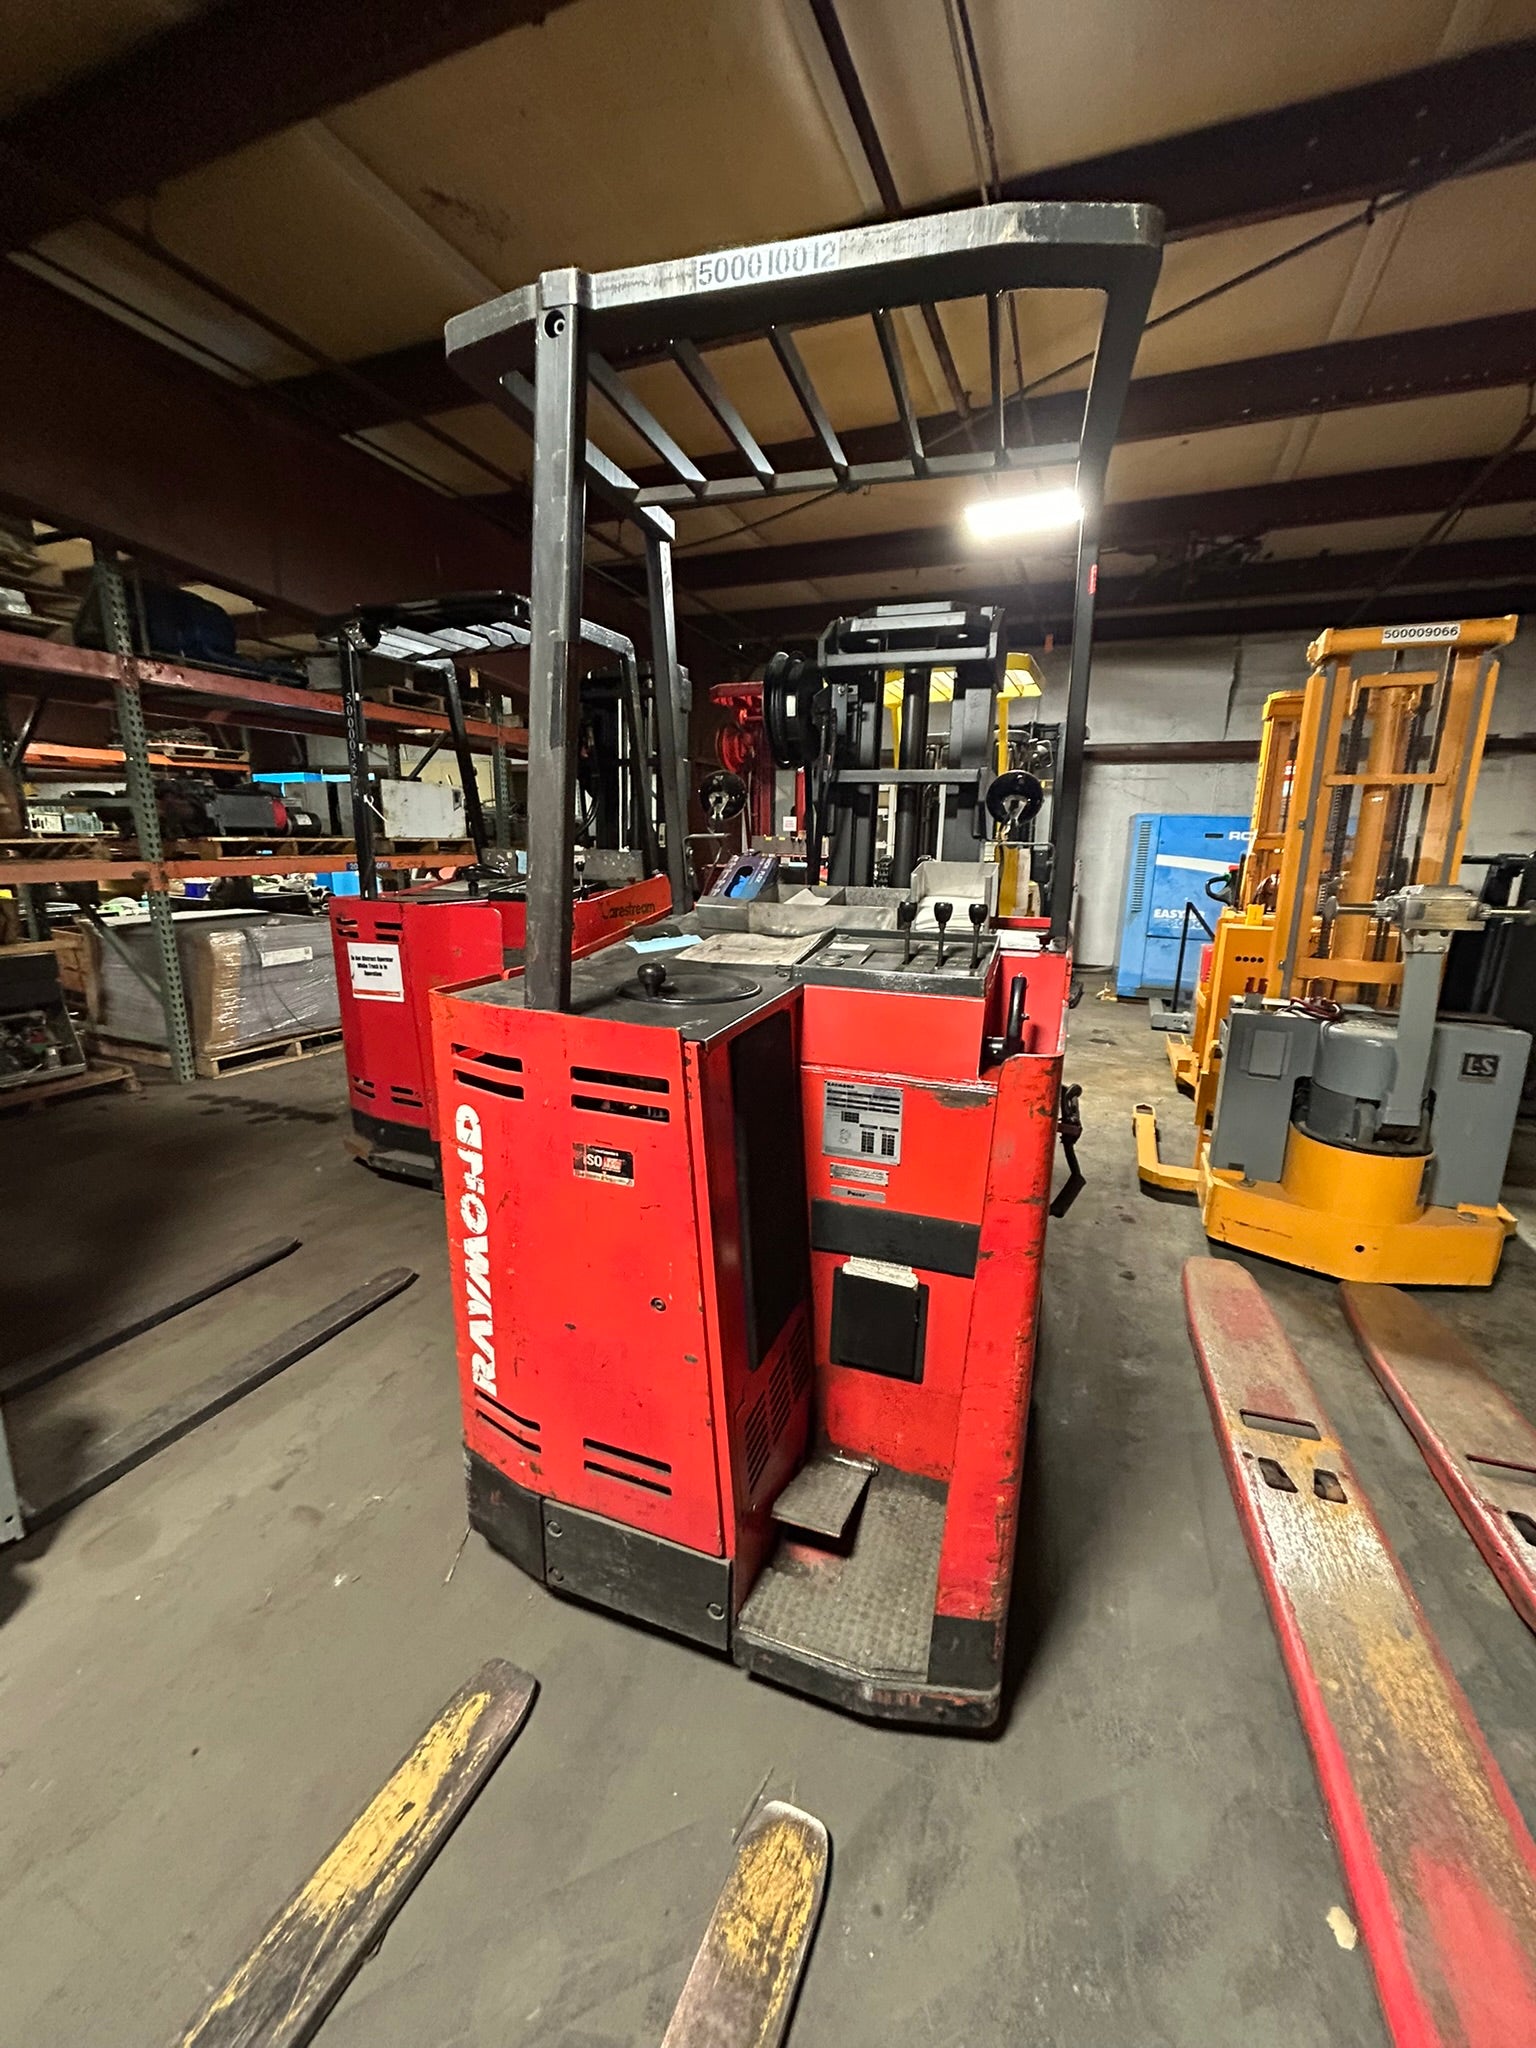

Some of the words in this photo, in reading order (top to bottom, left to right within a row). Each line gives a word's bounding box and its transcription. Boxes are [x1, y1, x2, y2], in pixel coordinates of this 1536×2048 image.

[698, 240, 837, 286] 500010012
[1384, 626, 1459, 639] 500009066
[455, 1104, 498, 1397] RAYMOND
